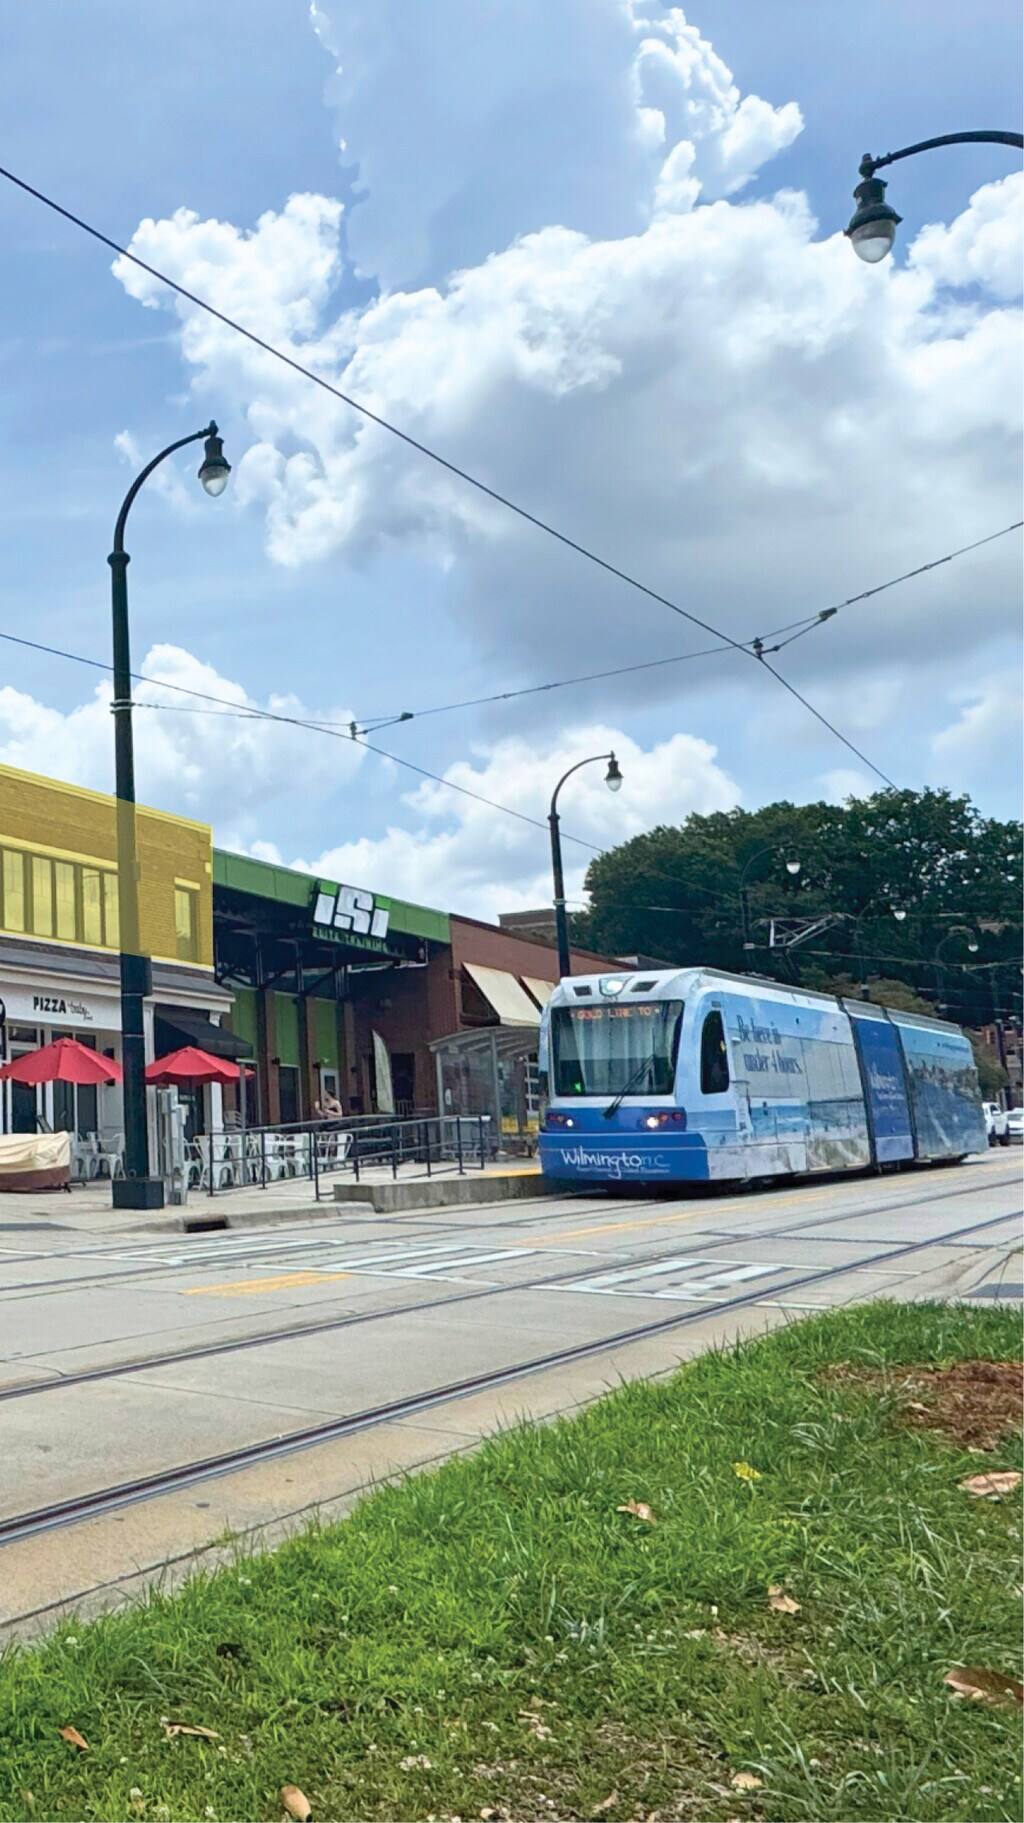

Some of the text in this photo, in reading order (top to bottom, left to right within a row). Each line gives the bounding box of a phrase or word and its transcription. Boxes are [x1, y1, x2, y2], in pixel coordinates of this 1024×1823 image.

[33, 996, 67, 1014] PIZZA
[638, 1006, 651, 1016] TO
[736, 1014, 750, 1042] Be
